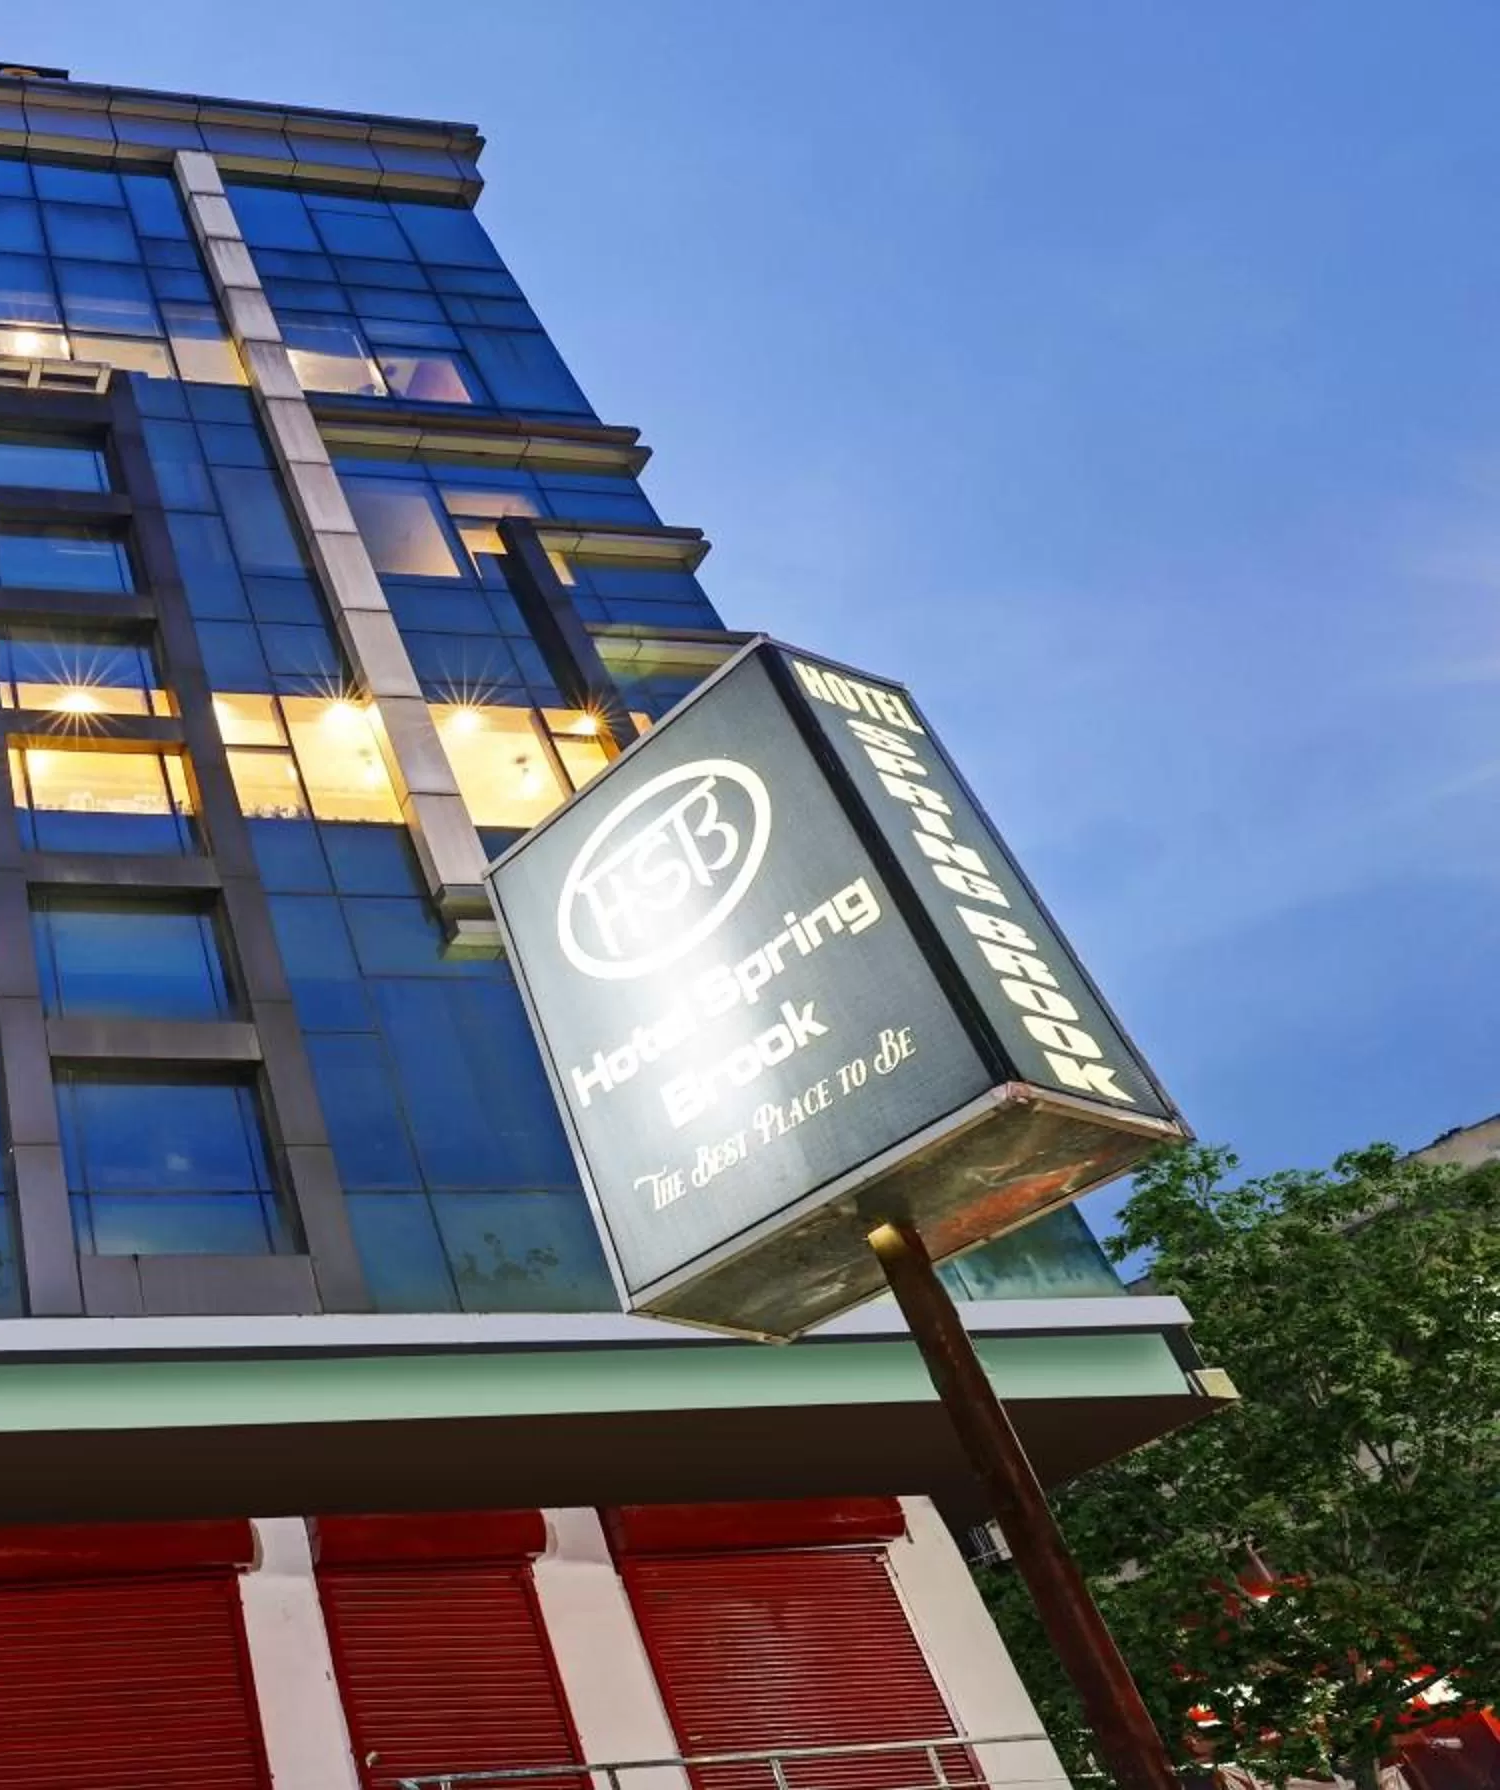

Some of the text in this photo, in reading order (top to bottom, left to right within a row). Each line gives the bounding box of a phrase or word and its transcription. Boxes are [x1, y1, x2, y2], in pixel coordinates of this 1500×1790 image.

[792, 660, 925, 735] HOTEL
[571, 876, 882, 1108] Hotl Spring
[846, 719, 1136, 1103] SPRING BROOK
[659, 1000, 830, 1129] Brook
[691, 1130, 749, 1188] BEST
[752, 1078, 833, 1145] PLACE
[835, 1058, 868, 1097] TO
[873, 1026, 917, 1076] BE
